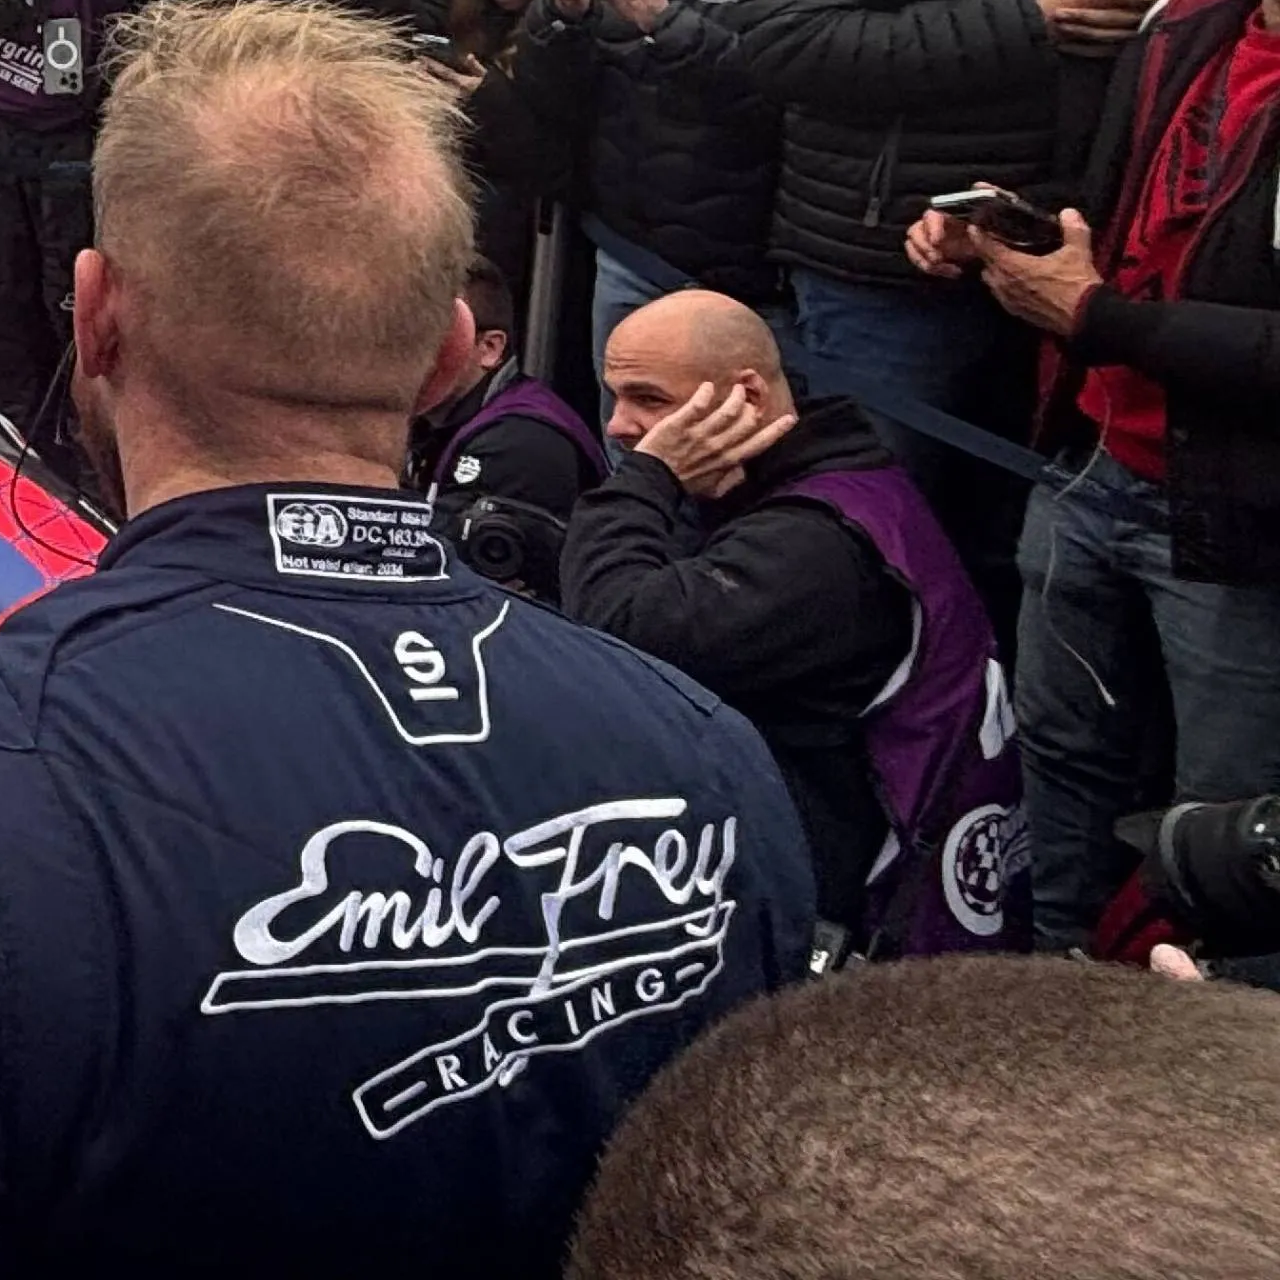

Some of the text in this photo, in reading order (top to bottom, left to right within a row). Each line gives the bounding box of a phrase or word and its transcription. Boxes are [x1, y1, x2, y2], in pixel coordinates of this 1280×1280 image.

[282, 554, 308, 568] Not
[311, 556, 341, 571] valid
[234, 797, 738, 997] Emil Frey
[438, 967, 667, 1091] RACING
